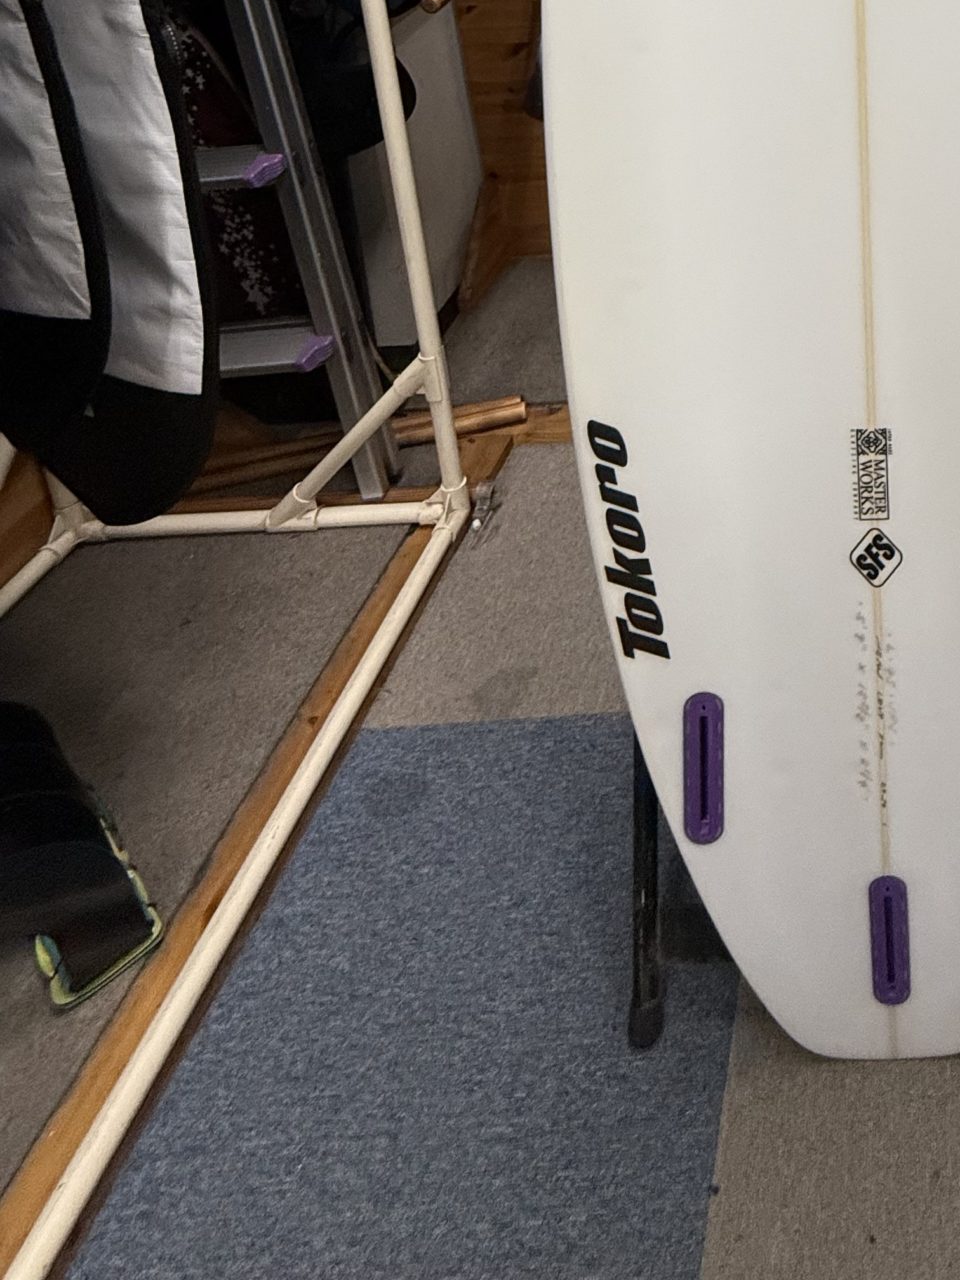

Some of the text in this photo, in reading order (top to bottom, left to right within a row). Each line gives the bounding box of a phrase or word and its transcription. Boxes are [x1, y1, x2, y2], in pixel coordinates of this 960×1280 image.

[859, 459, 874, 516] WORKS
[873, 458, 887, 515] MASTER
[587, 420, 671, 660] Tokoro
[855, 533, 896, 581] SFS
